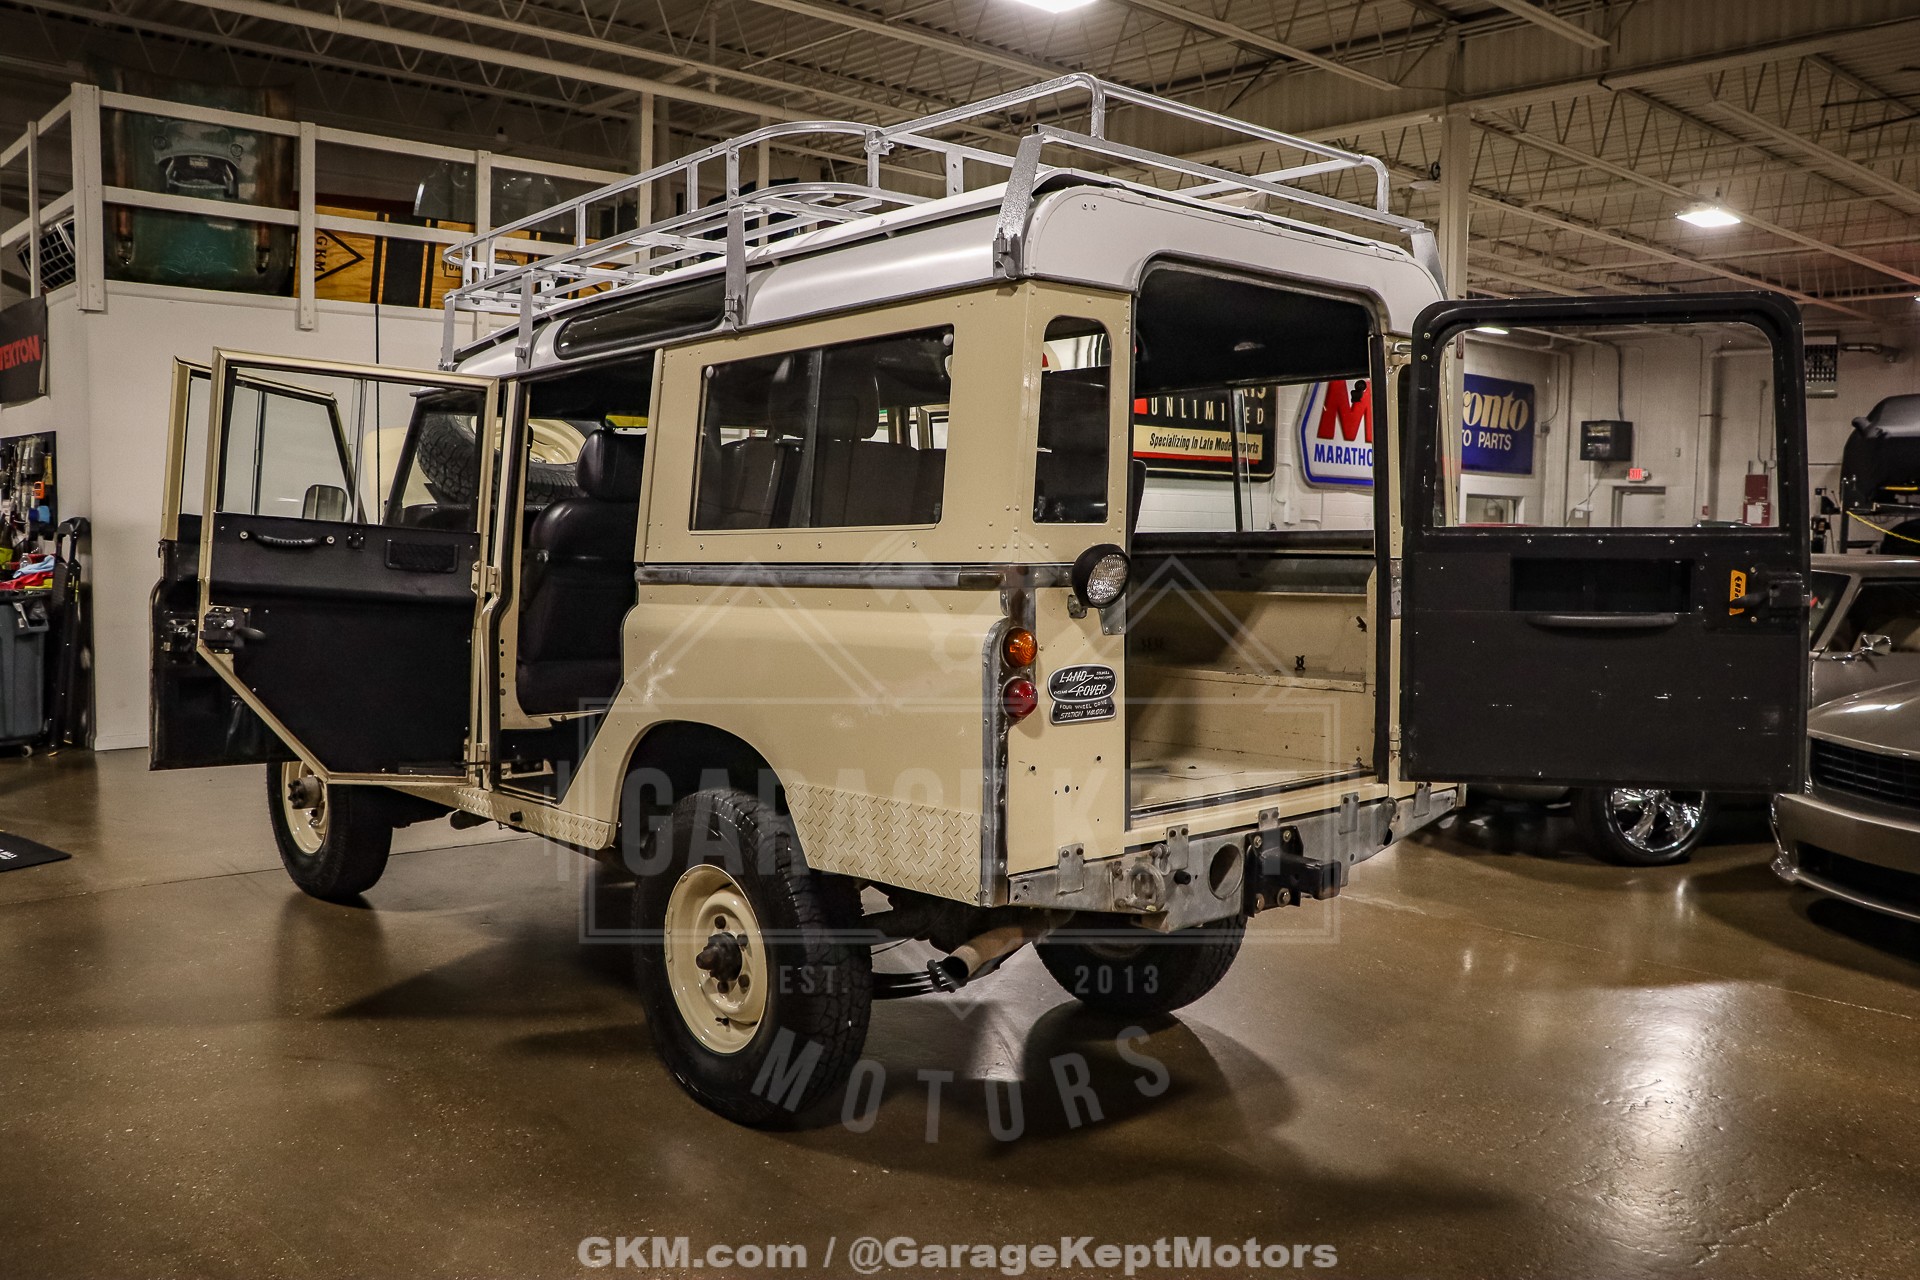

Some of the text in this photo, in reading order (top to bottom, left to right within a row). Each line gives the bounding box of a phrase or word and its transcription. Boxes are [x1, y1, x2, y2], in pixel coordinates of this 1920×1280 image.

[1150, 396, 1265, 425] UNLIMIED
[1149, 432, 1191, 451] Specializing
[1214, 437, 1233, 451] Mode
[1478, 431, 1512, 451] PARTS
[1734, 582, 1742, 598] PEN
[1059, 671, 1087, 683] LAND
[1076, 684, 1107, 696] ROVER
